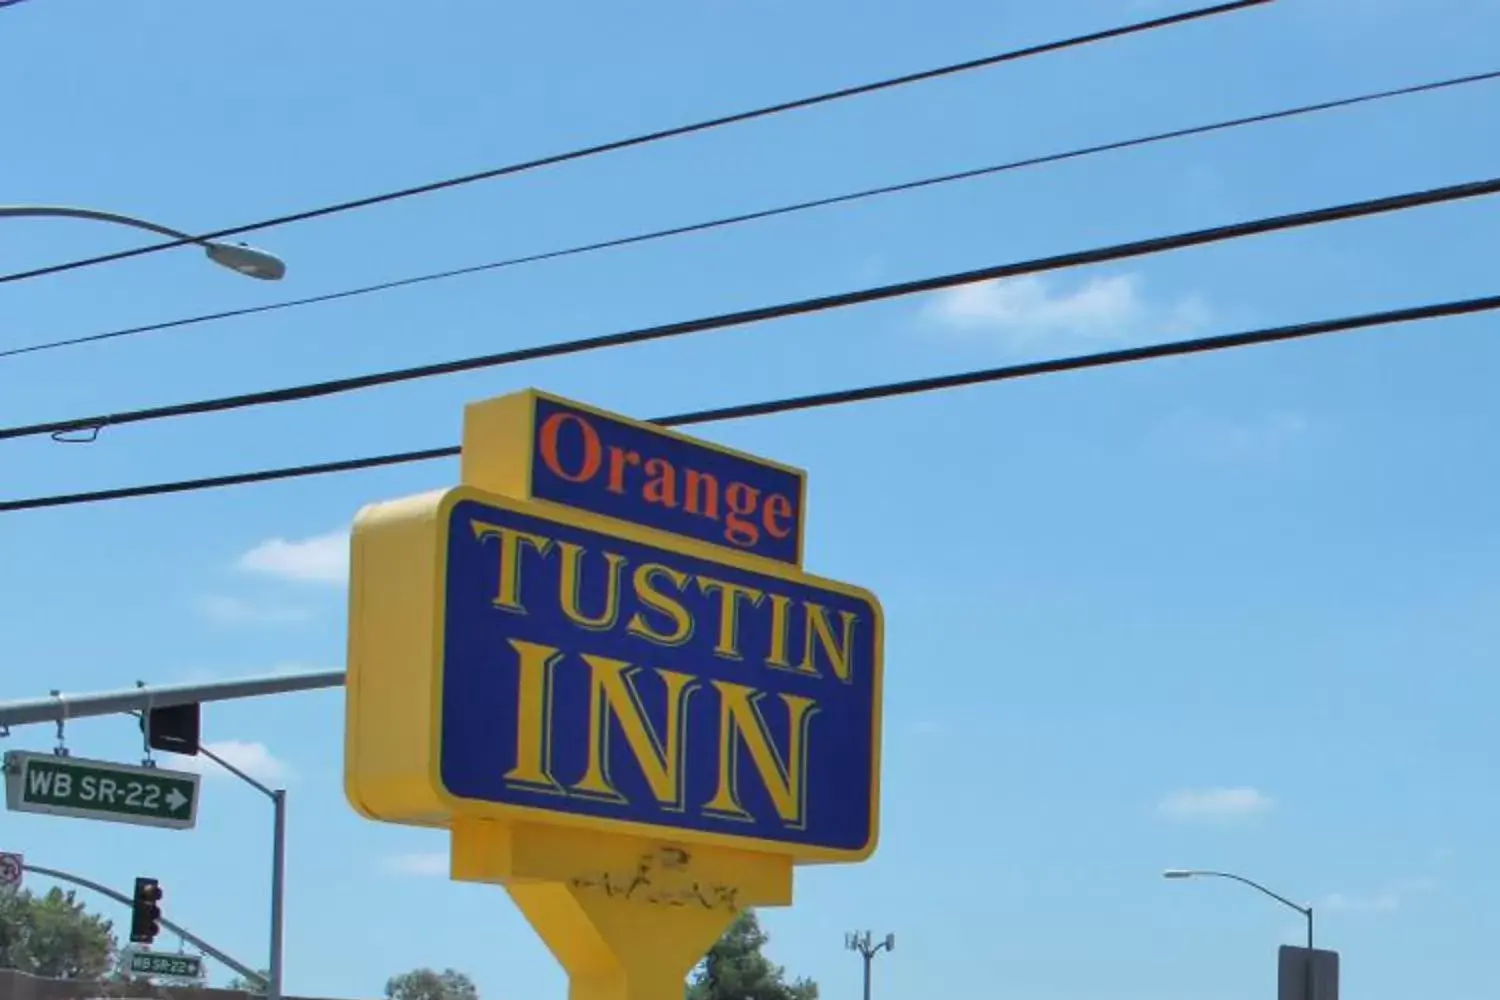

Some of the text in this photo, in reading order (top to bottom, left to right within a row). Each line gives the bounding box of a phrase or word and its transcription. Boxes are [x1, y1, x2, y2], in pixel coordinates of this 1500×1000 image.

[540, 411, 793, 547] Orange
[470, 519, 861, 683] TUSTIN
[29, 769, 161, 810] WB SR-22
[503, 638, 821, 831] INN
